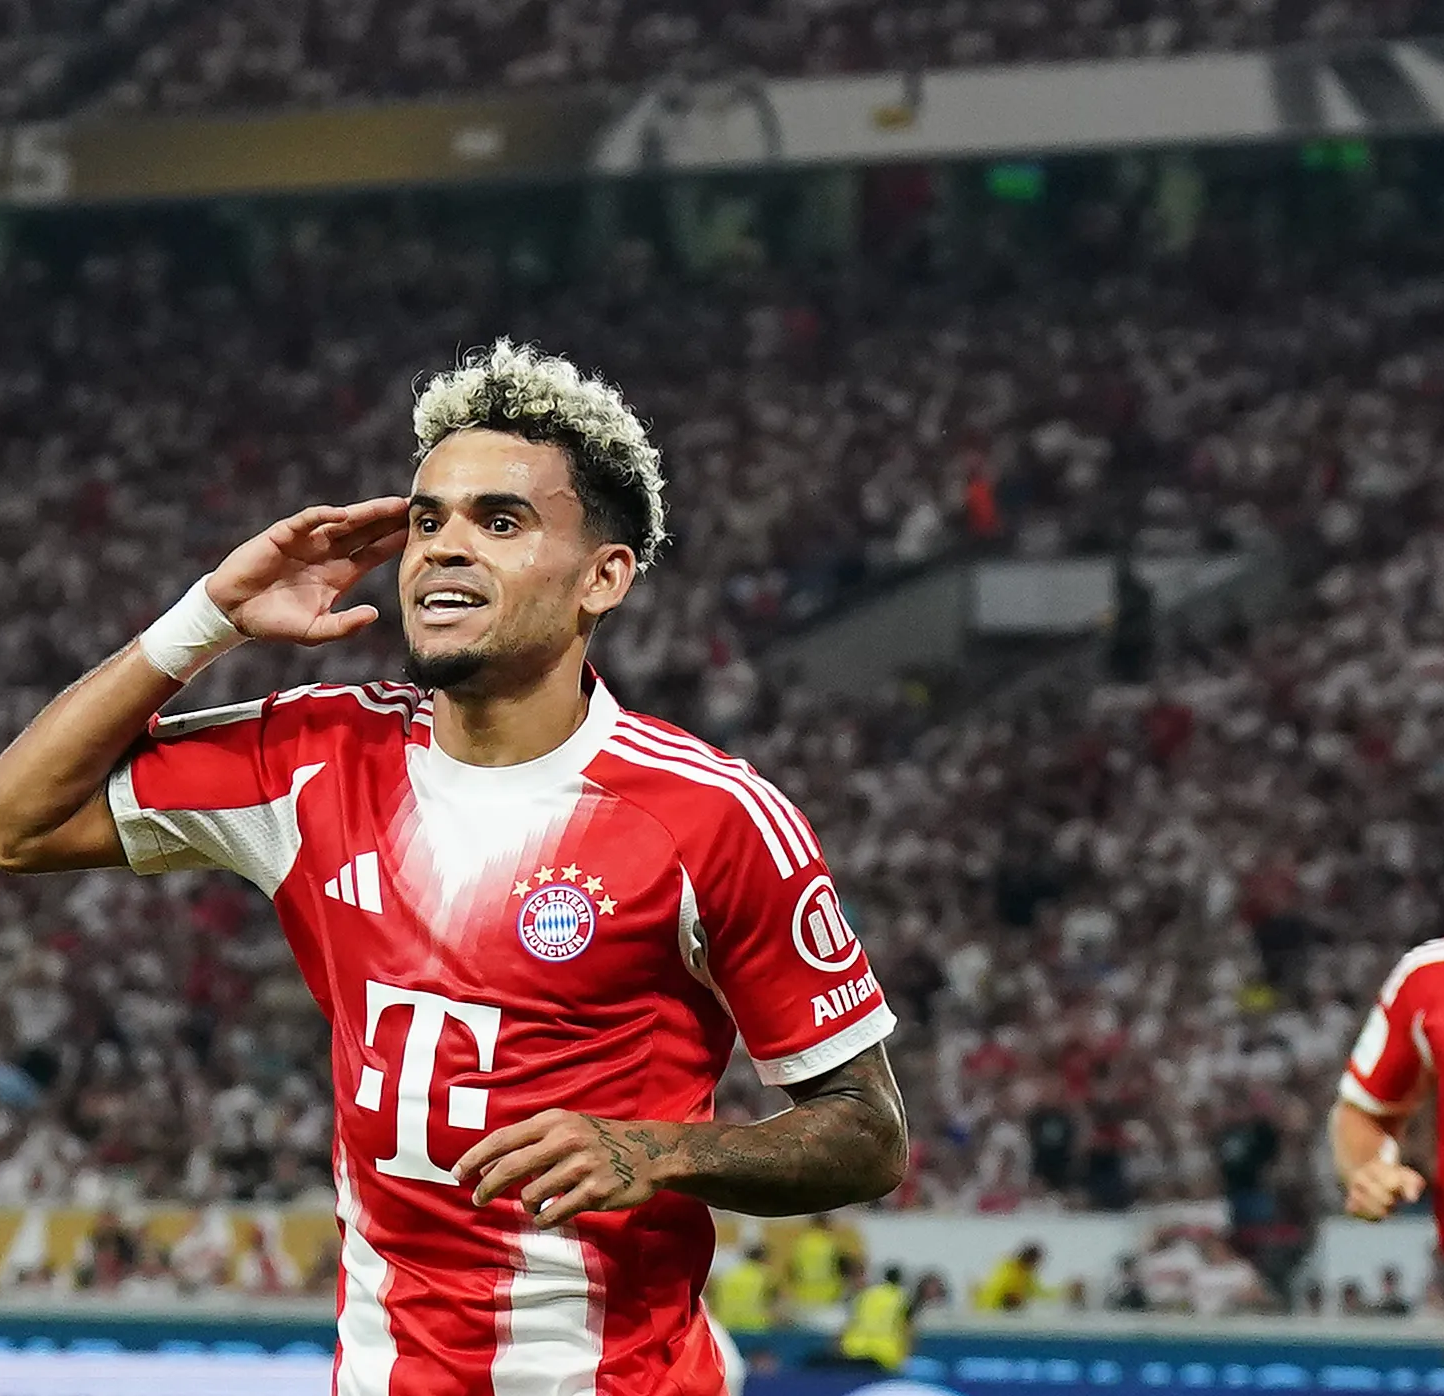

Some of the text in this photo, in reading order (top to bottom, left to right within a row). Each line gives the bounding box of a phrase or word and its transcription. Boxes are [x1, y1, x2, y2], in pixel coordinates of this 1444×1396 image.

[528, 890, 590, 924] FC BAYERN
[810, 969, 878, 1028] Allian
[354, 979, 502, 1187] T
